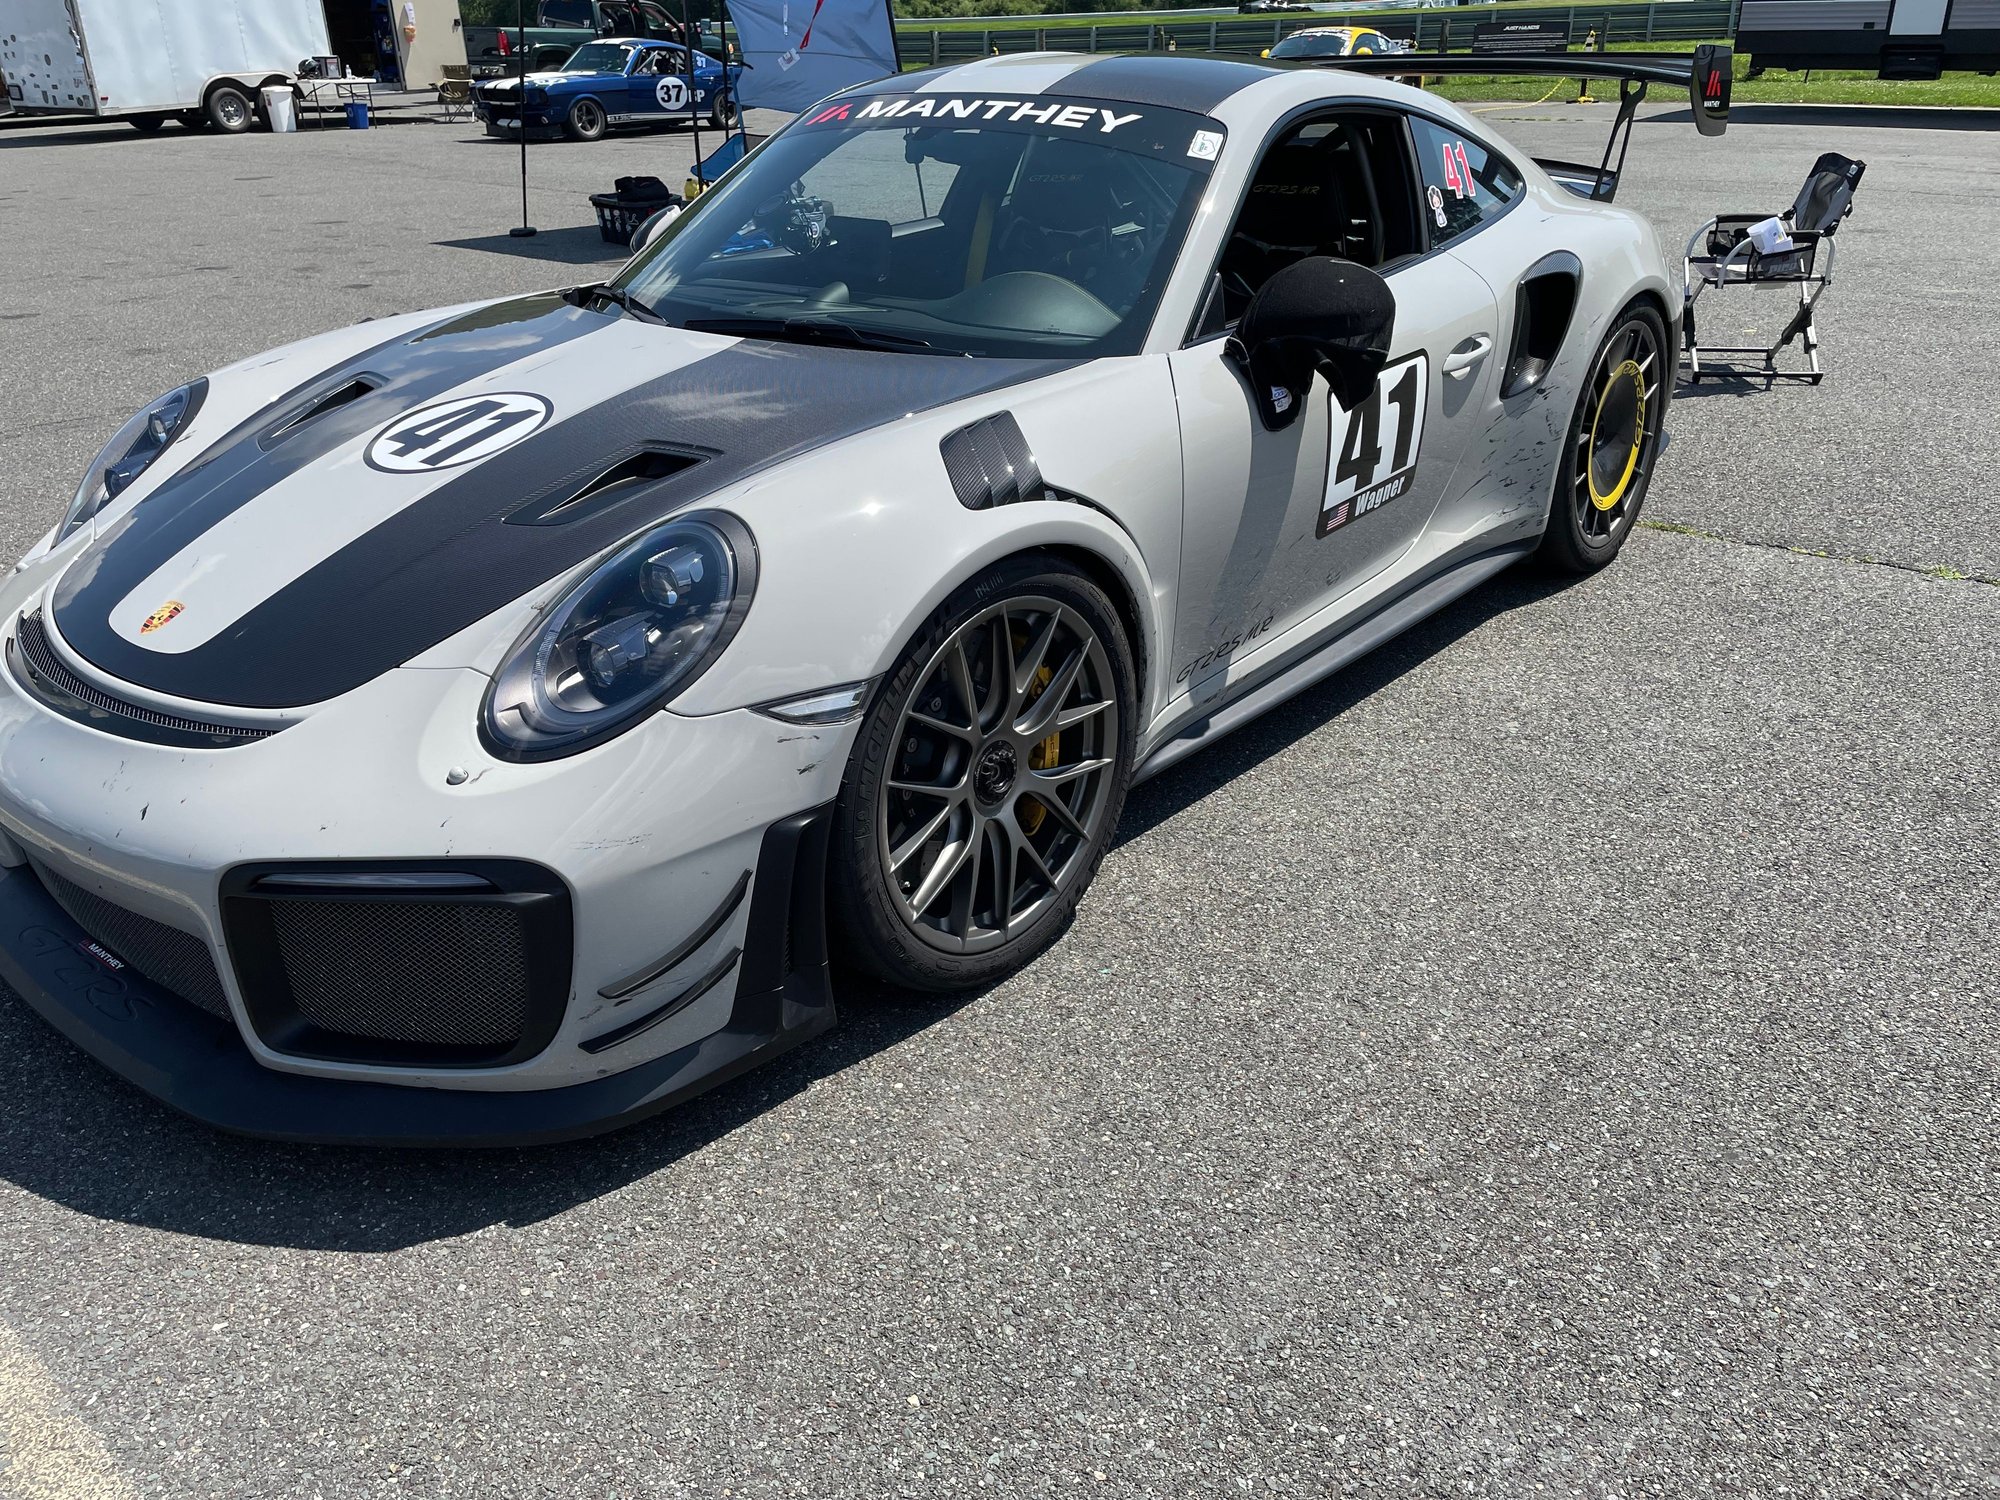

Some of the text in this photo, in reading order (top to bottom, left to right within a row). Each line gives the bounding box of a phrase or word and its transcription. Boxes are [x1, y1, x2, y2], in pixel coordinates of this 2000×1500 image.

[660, 84, 683, 103] 37
[855, 99, 1144, 132] MANTHEY
[1443, 141, 1476, 199] 41
[385, 400, 542, 467] 41
[1335, 364, 1418, 493] 41
[1354, 476, 1406, 517] Wagner
[857, 655, 923, 800] MICHELIN
[88, 943, 125, 970] MANTHEY
